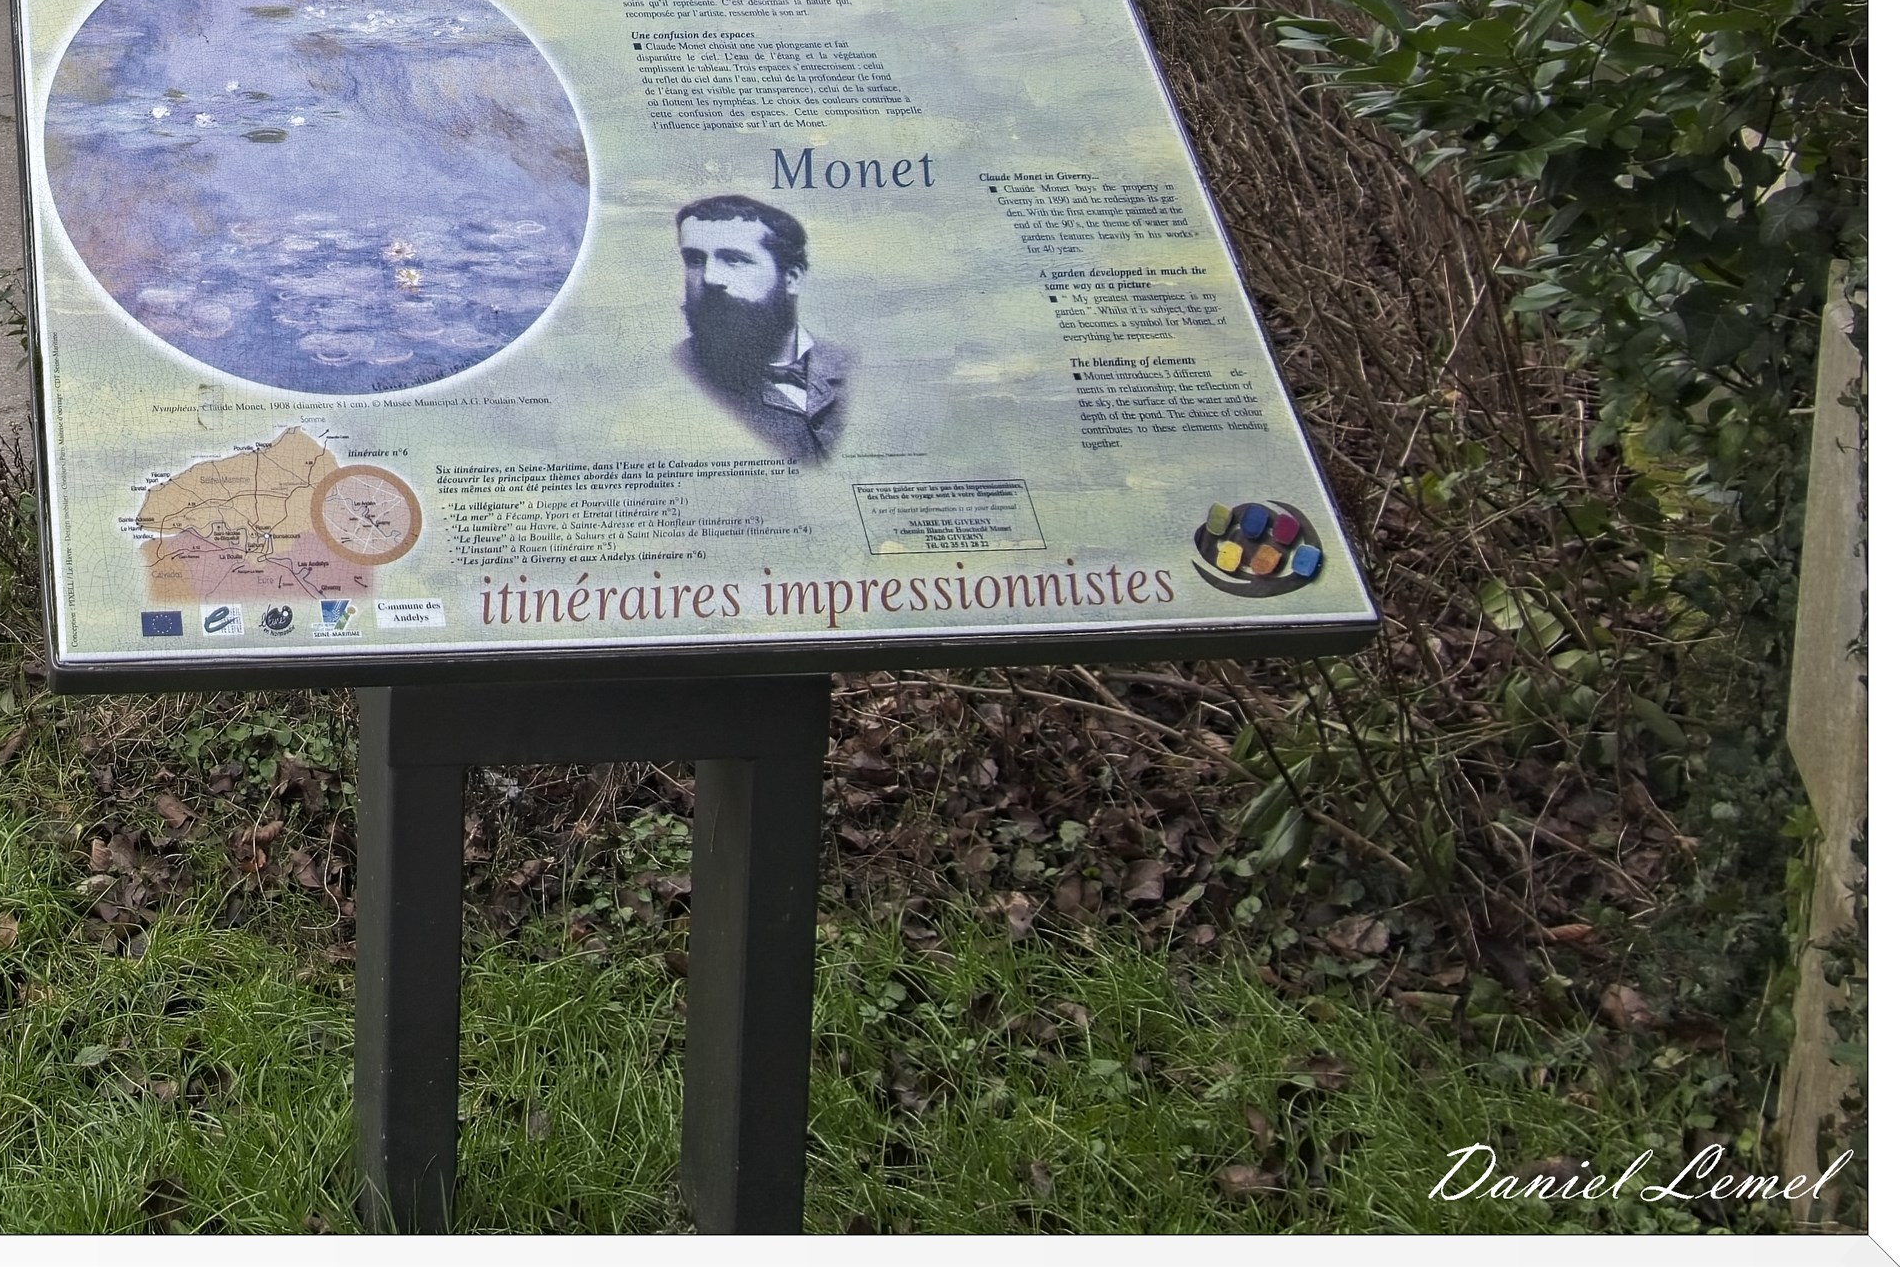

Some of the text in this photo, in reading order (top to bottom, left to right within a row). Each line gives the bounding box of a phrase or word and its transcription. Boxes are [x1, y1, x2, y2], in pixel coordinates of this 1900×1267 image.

[631, 31, 650, 39] Une
[653, 30, 699, 39] confusion
[702, 30, 717, 38] des
[645, 42, 676, 50] Claude
[708, 41, 737, 49] choisit
[775, 41, 821, 50] plongeante
[655, 75, 678, 84] reflet
[694, 75, 710, 83] ciel
[761, 74, 782, 82] celui
[808, 74, 854, 83] profondeur
[703, 120, 743, 130] japonaise
[783, 119, 794, 127] de
[770, 148, 936, 190] Monet
[979, 173, 1010, 181] Claude
[1051, 268, 1085, 279] garden
[1089, 267, 1142, 278] developped
[1146, 267, 1156, 275] in
[1160, 266, 1187, 275] much
[1191, 266, 1206, 274] the
[1072, 283, 1091, 291] way
[1117, 280, 1150, 291] picture
[1069, 356, 1195, 367] The blending of elements
[414, 398, 458, 407] Municipal
[348, 449, 389, 457] itinéraire
[435, 465, 450, 474] Six
[657, 460, 665, 468] le
[668, 460, 708, 468] Calvados
[733, 459, 784, 468] permettront
[436, 475, 480, 484] découvrir
[482, 474, 494, 482] les
[497, 474, 546, 484] principaux
[549, 473, 580, 481] thèmes
[583, 471, 618, 480] abordés
[656, 471, 693, 480] peinture
[438, 485, 457, 493] sites
[461, 484, 491, 493] mêmes
[494, 483, 505, 492] où
[526, 483, 538, 491] été
[541, 483, 572, 492] peintes
[624, 480, 674, 490] reproduites
[521, 555, 527, 563] à
[530, 554, 565, 564] Giverny
[599, 552, 635, 562] Andelys
[638, 551, 683, 560] (itinéraire
[480, 558, 1176, 629] itinéraires impressionnistes
[426, 601, 441, 610] des
[393, 612, 430, 623] Andelys
